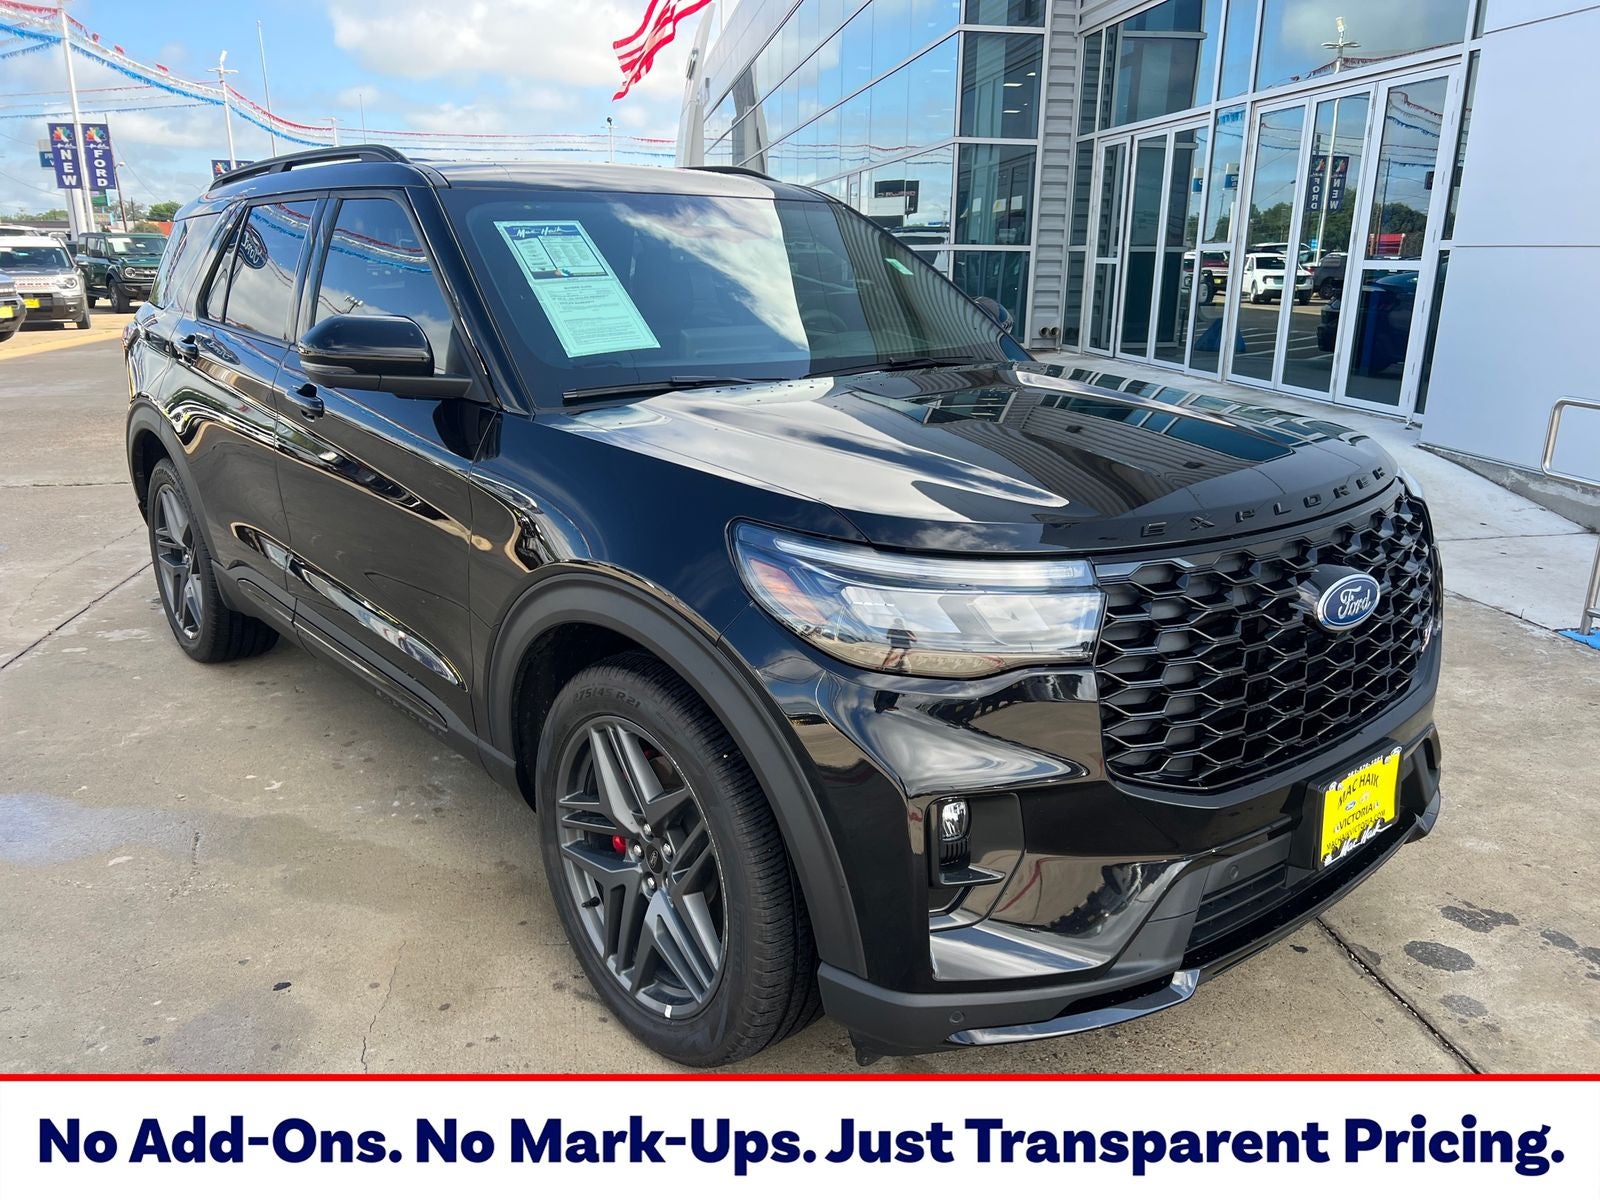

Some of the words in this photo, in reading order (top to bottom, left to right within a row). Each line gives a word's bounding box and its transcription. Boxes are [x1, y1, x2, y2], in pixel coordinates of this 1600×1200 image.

[60, 149, 77, 186] NEW
[93, 149, 108, 187] FORD
[1140, 466, 1386, 538] EXPLORER
[1337, 584, 1372, 620] Ford
[1338, 778, 1358, 808] MAC
[1359, 773, 1379, 788] HAIK
[1339, 803, 1373, 830] VICTORIA
